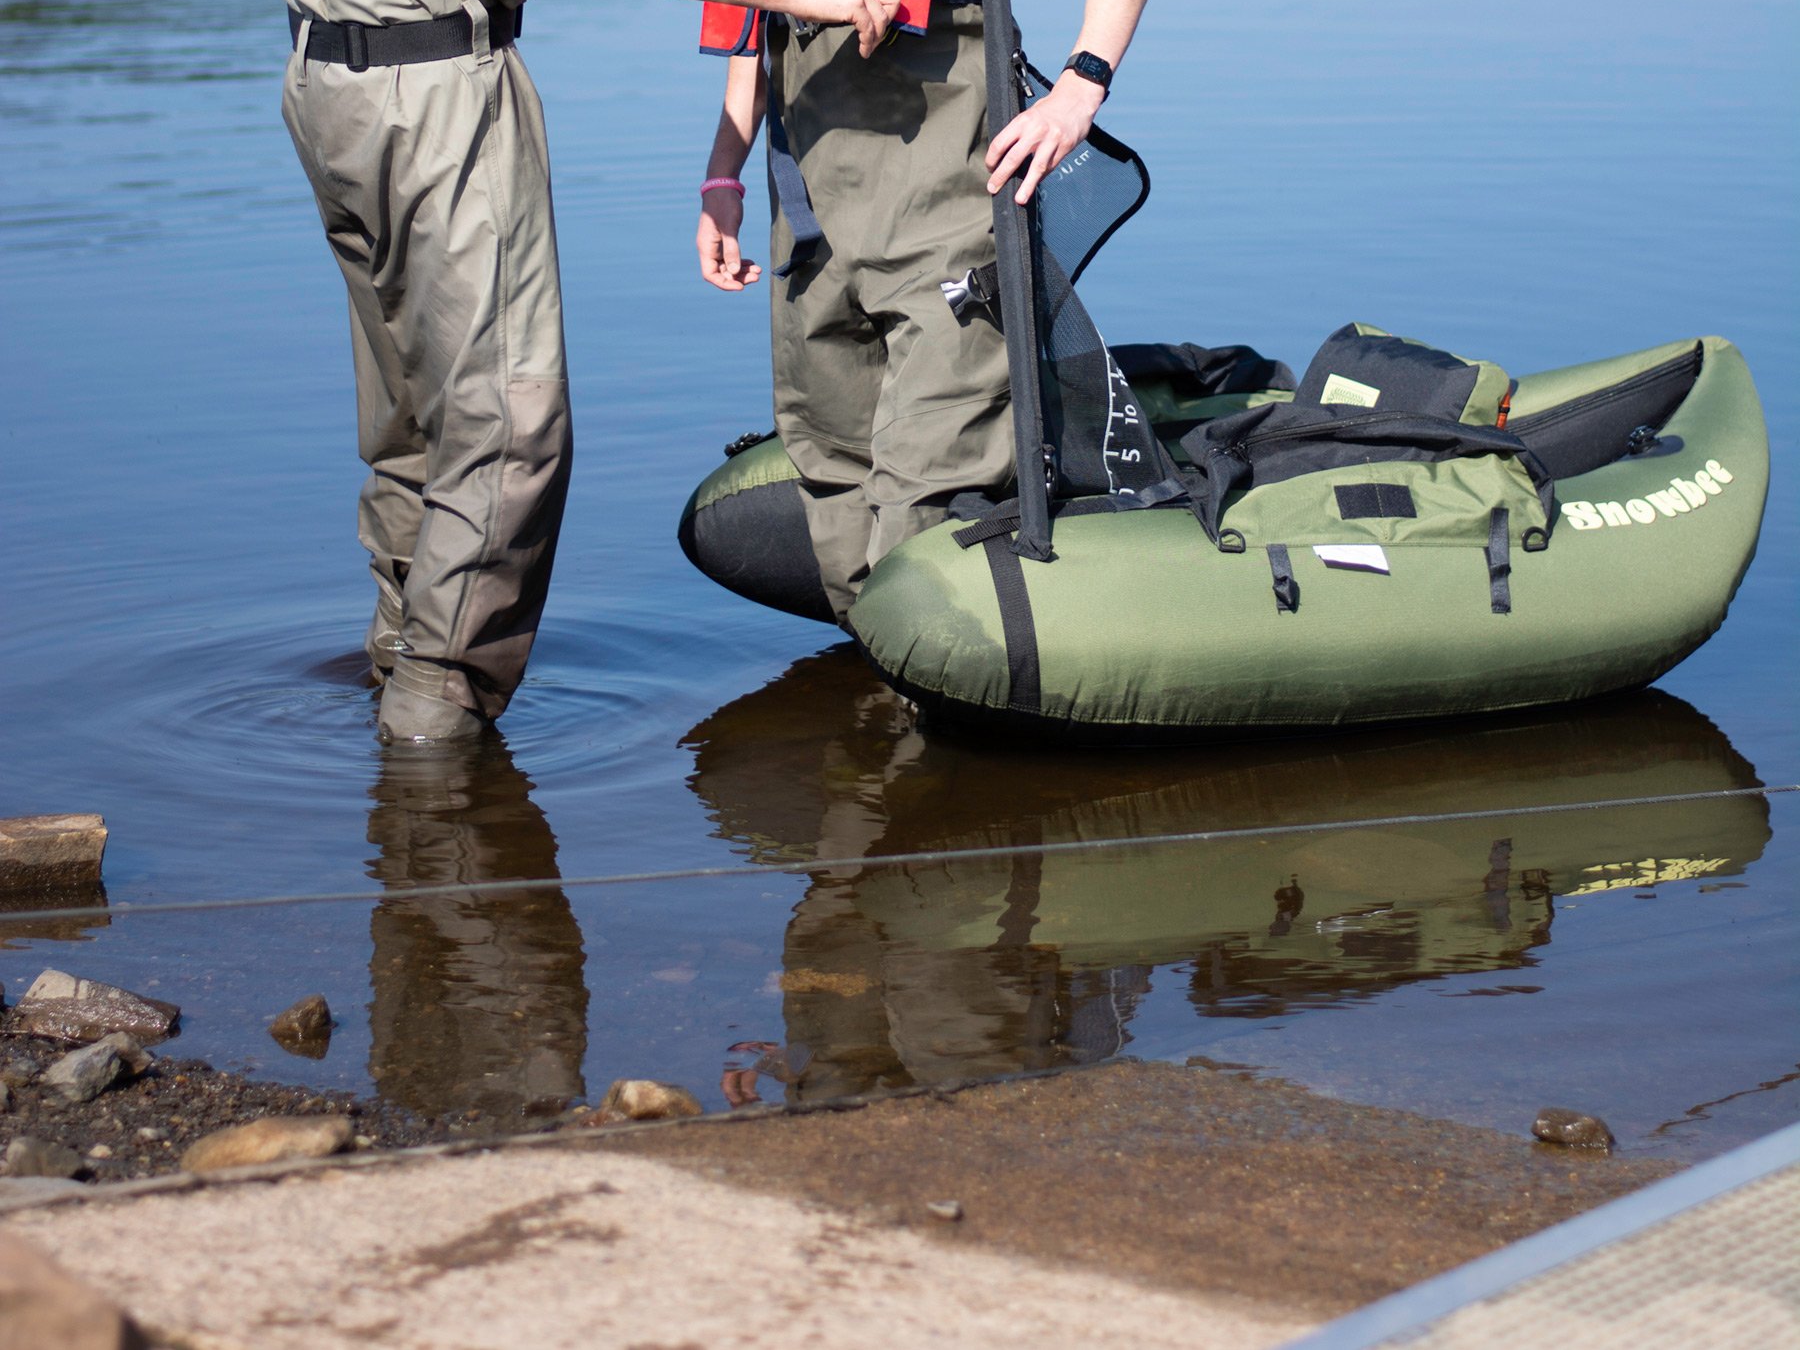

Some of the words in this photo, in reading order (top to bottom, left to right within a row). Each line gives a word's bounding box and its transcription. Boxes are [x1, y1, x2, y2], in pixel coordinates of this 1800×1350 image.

[1124, 404, 1139, 425] 10
[1121, 448, 1140, 463] 5
[1561, 459, 1734, 531] Snowbee
